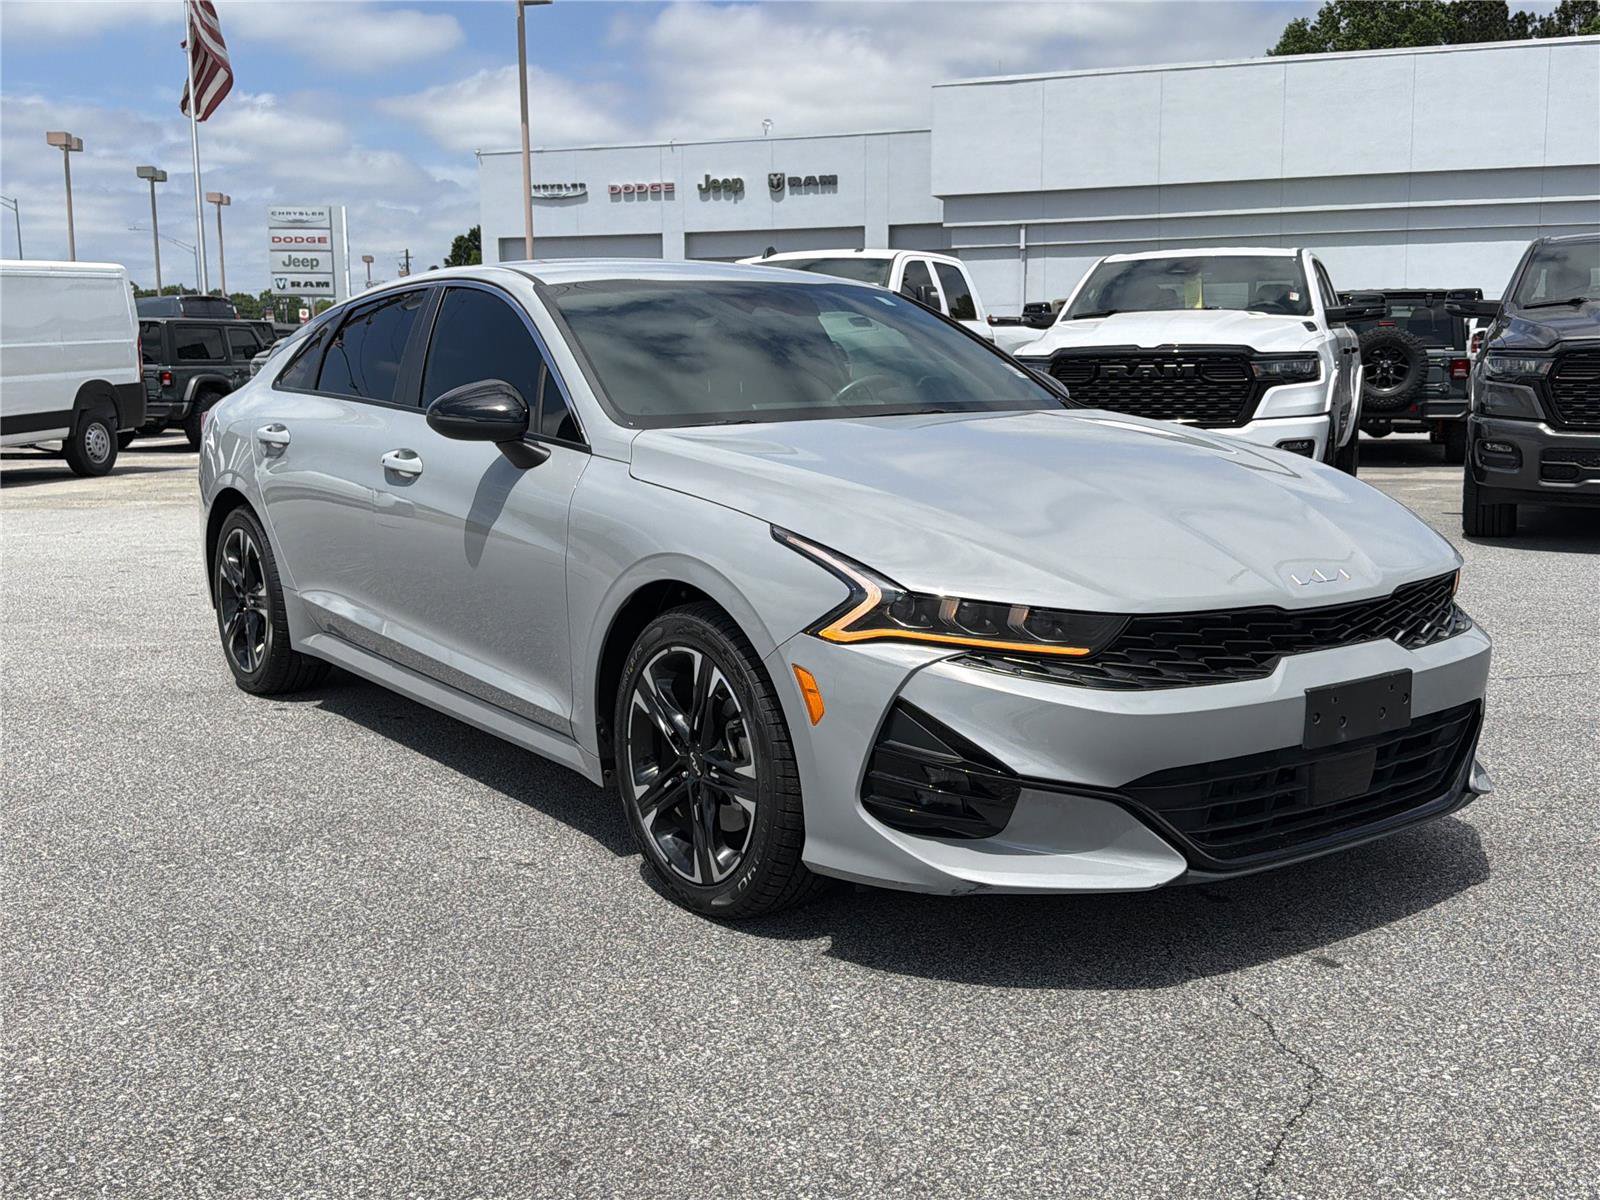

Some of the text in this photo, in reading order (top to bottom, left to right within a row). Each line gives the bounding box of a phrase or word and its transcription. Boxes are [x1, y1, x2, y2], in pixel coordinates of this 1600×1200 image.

[697, 174, 744, 194] Jeep
[787, 174, 838, 187] RAM
[532, 183, 586, 192] HRYSLER
[608, 183, 675, 194] DODGE
[271, 236, 328, 244] DODGE
[282, 254, 320, 270] Jeep
[1099, 363, 1196, 378] RAM
